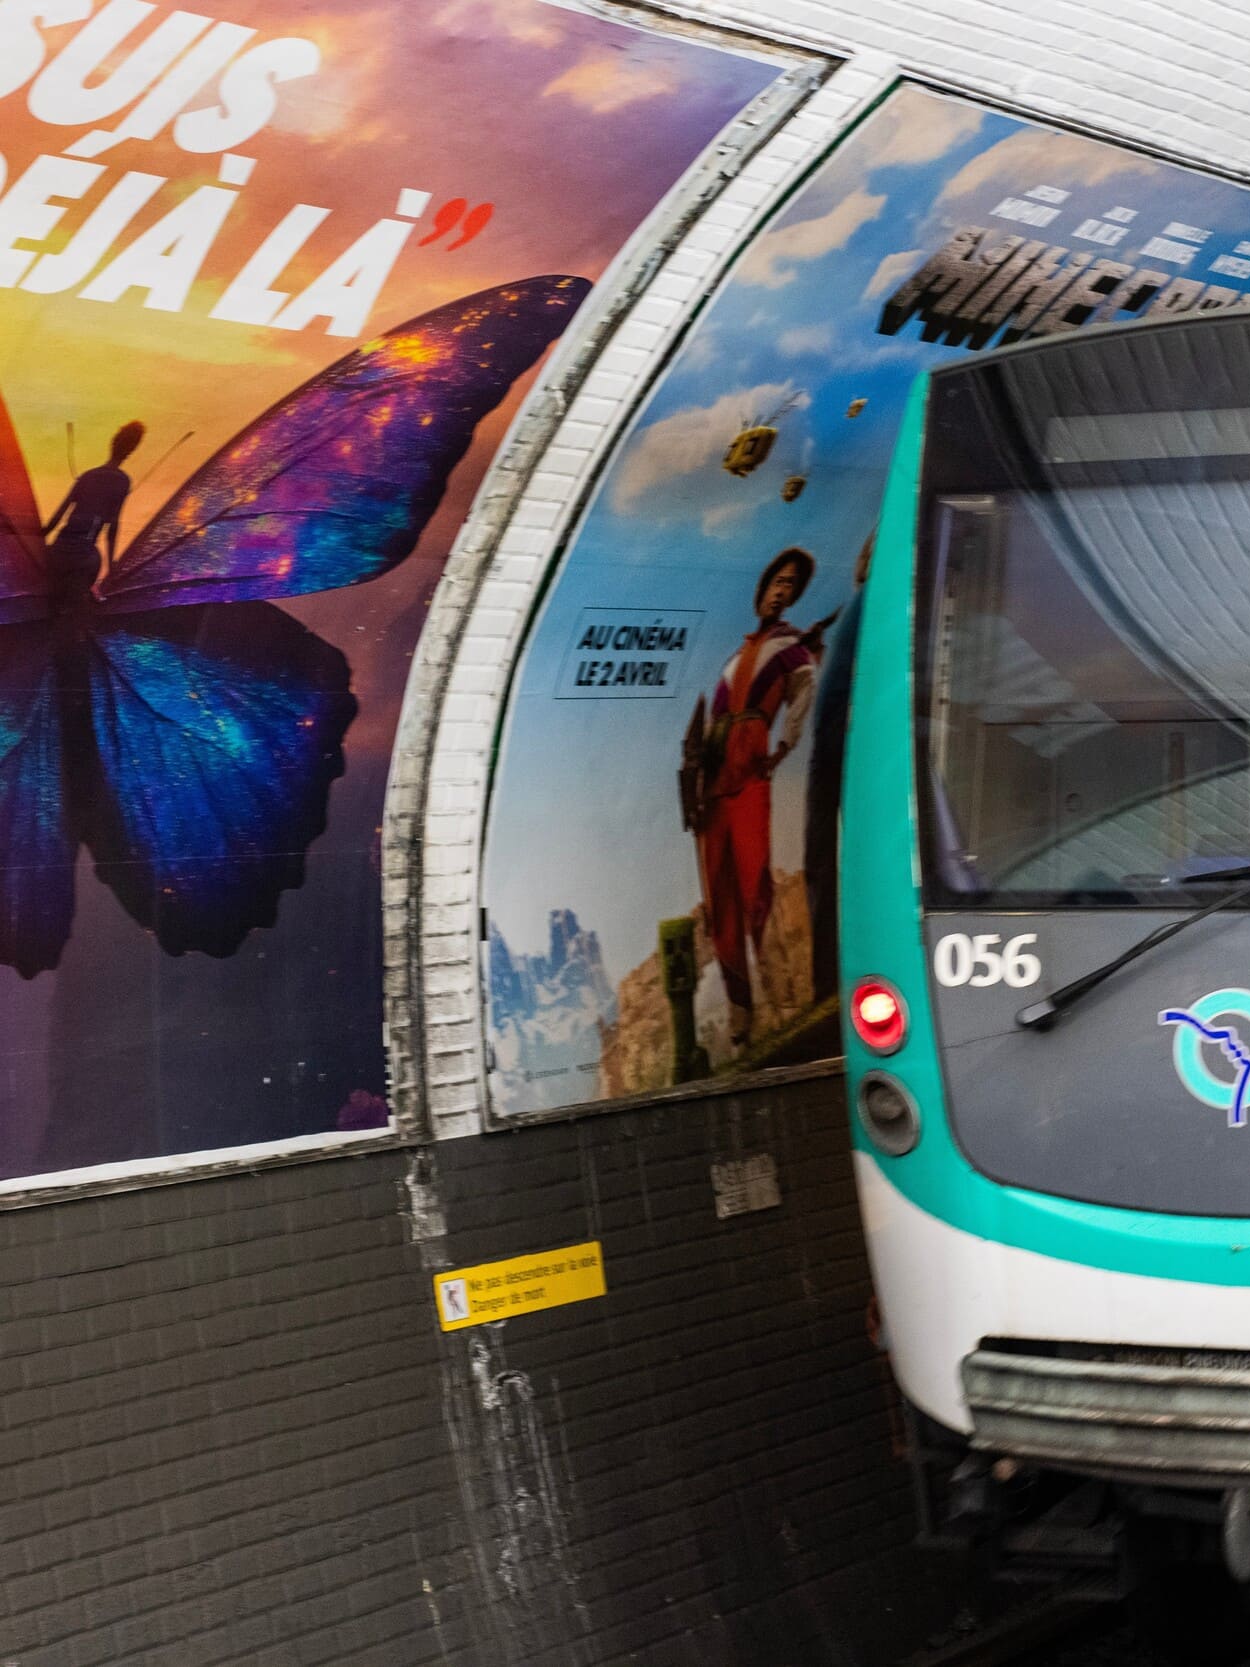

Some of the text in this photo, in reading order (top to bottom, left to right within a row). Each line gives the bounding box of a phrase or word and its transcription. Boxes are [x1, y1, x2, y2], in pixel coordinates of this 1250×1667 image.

[0, 0, 320, 153] SUIS
[0, 130, 257, 313] ÉJÀ
[576, 618, 689, 651] AU CINÉMA
[574, 661, 669, 686] LE 2 AVRIL
[933, 932, 1042, 988] 056
